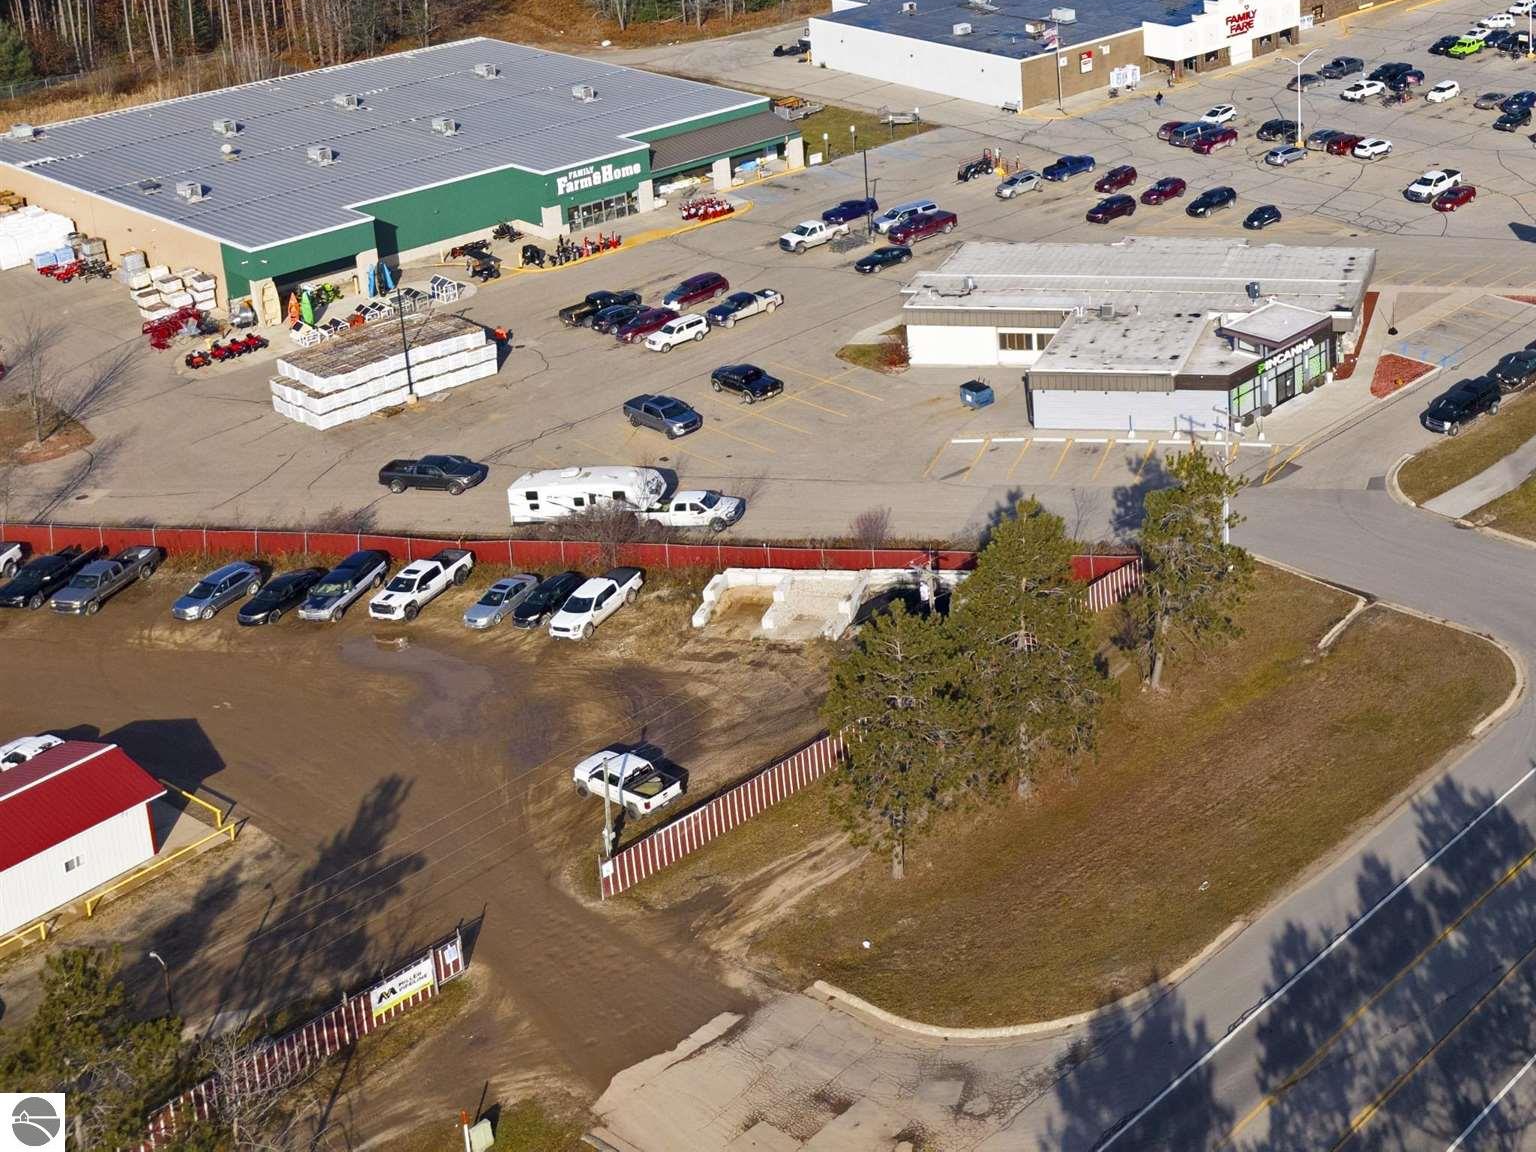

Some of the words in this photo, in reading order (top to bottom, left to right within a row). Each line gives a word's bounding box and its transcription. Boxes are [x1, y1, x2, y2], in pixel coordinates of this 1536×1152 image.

[1226, 9, 1257, 26] FAMILY
[1230, 20, 1255, 34] FARE
[568, 166, 594, 180] FAMILY
